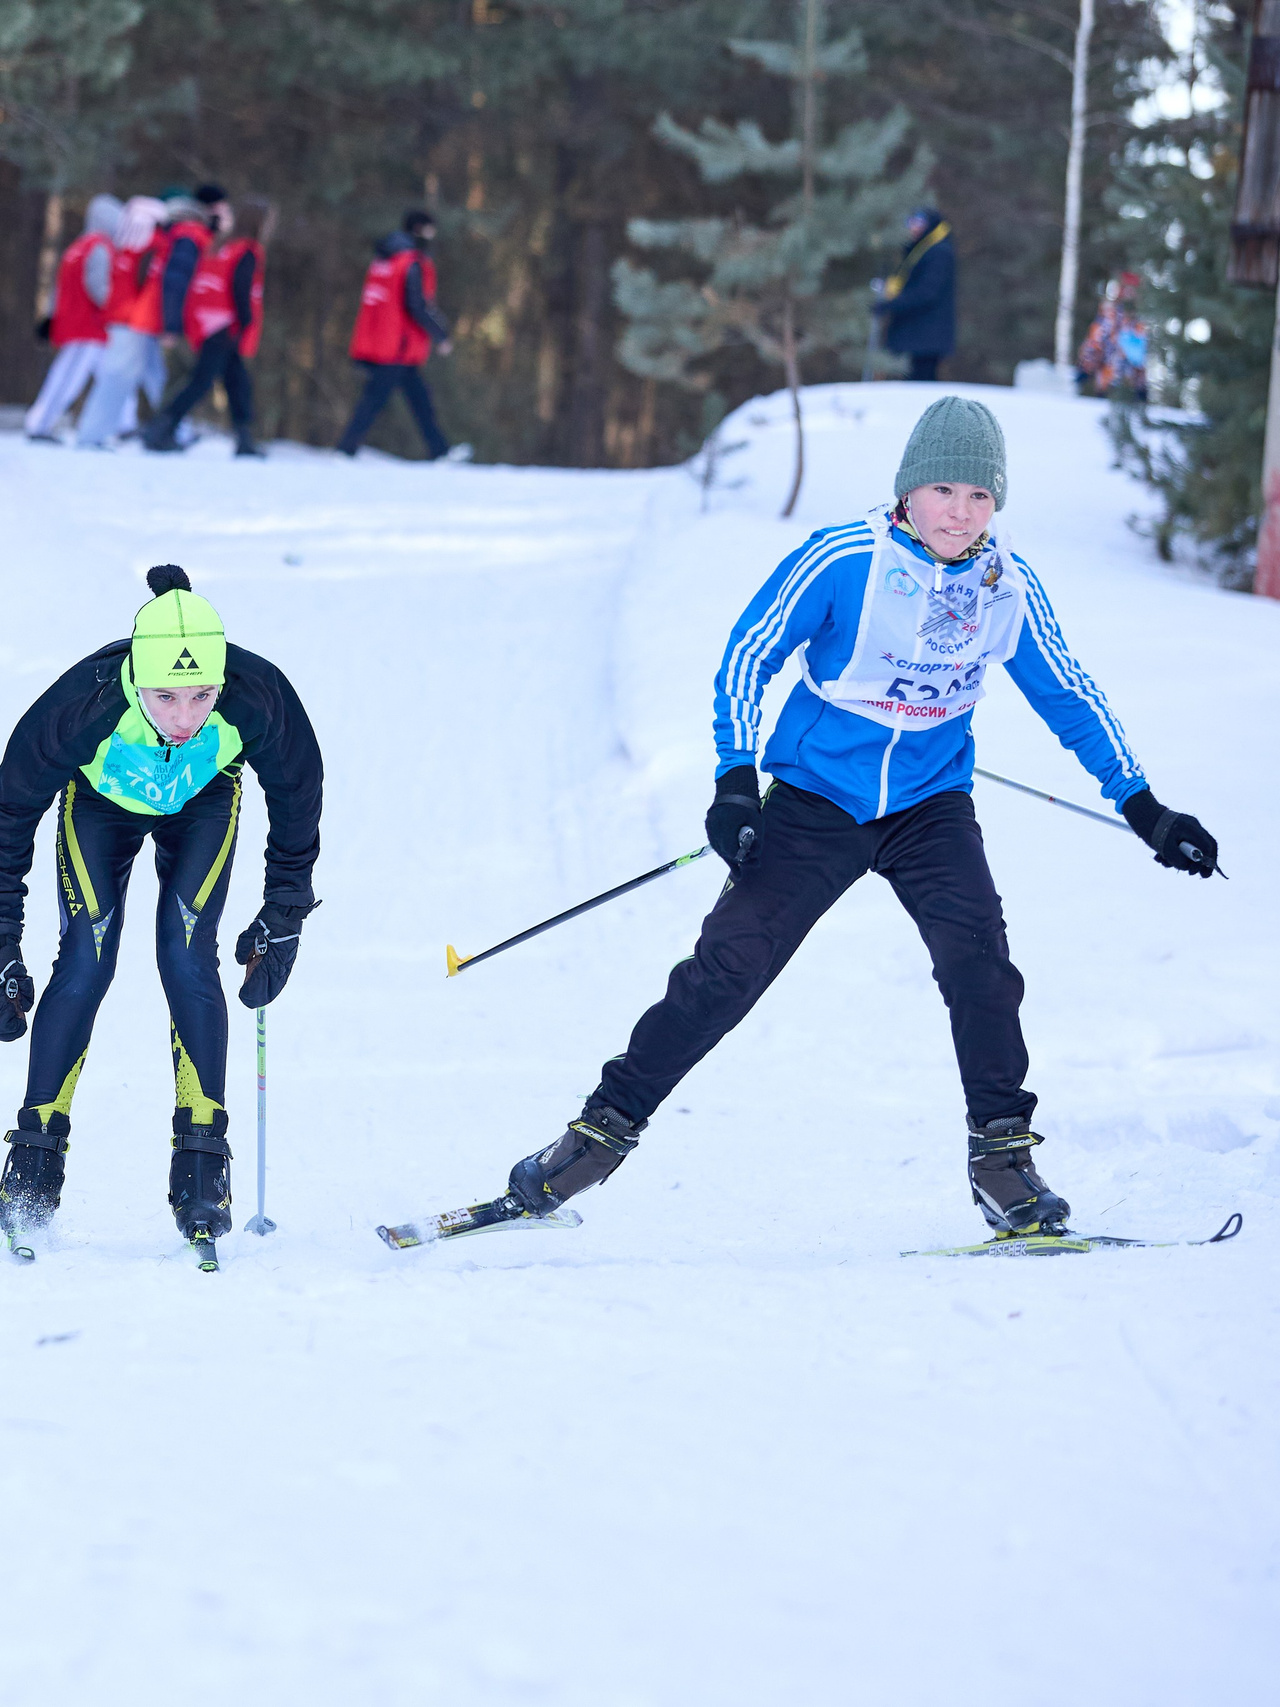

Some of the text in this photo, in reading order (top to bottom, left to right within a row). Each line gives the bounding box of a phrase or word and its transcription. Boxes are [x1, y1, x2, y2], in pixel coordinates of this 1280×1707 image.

[929, 583, 974, 598] ЛЖНЯ
[896, 703, 947, 718] РОССИИ
[57, 831, 76, 901] FISCHER
[988, 1241, 1028, 1257] FISCHER
